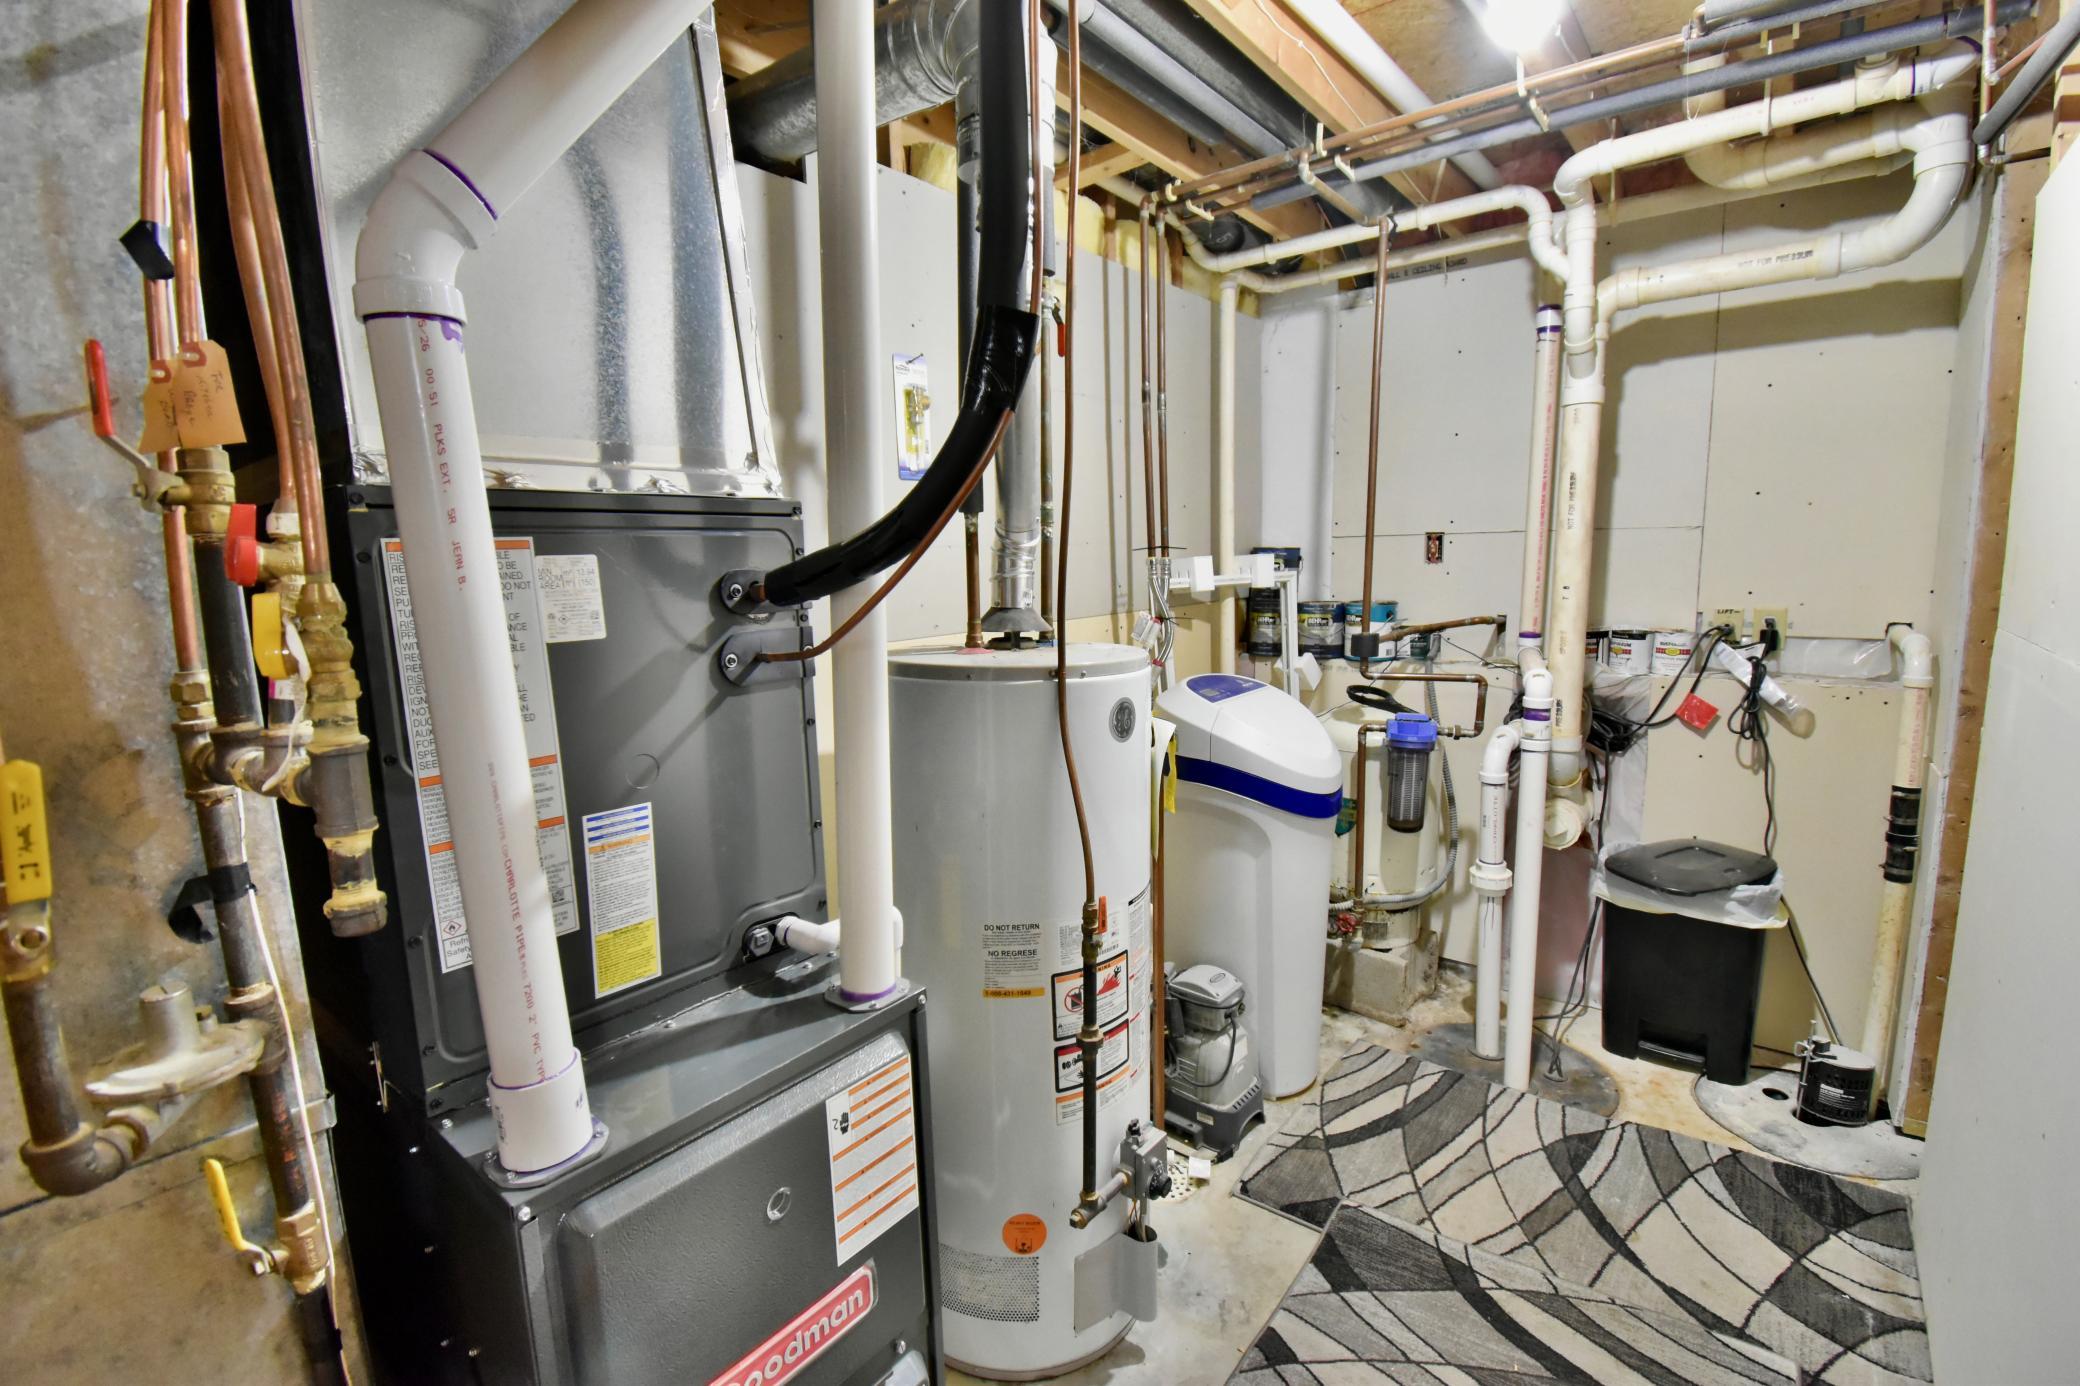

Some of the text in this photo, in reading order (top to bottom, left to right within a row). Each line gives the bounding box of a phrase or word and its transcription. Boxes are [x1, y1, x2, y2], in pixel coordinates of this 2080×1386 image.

[983, 922, 1041, 932] DO NOT RETURN
[987, 948, 1038, 958] NO REGRESE
[536, 1058, 545, 1081] TYP
[727, 1289, 865, 1386] oodman
